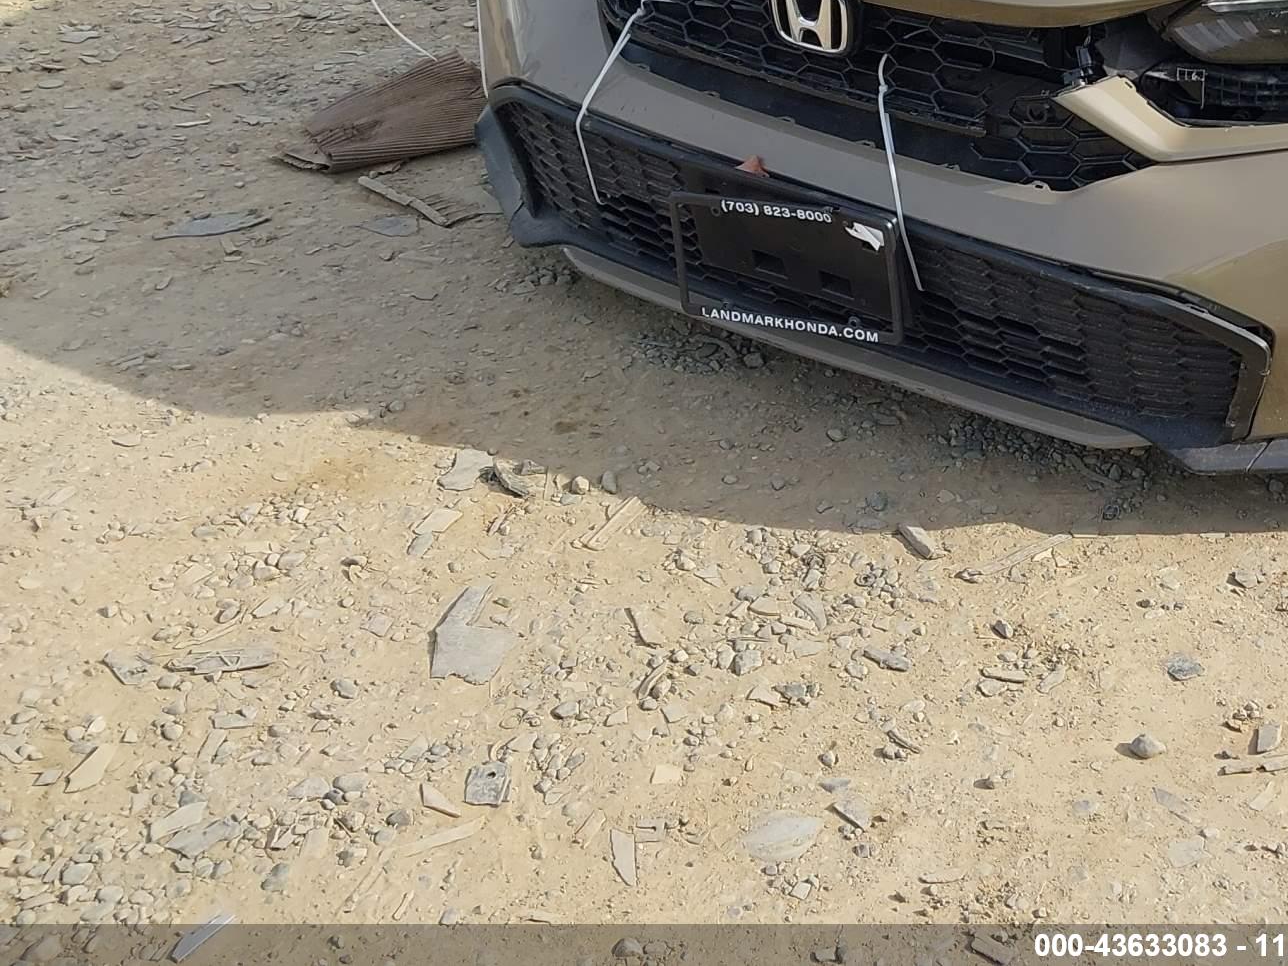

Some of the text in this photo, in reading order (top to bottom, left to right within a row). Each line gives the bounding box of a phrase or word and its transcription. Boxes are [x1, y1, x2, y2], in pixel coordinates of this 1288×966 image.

[720, 199, 832, 223] (703) 823-8000
[701, 307, 879, 342] LANDMARKHONDA.COM
